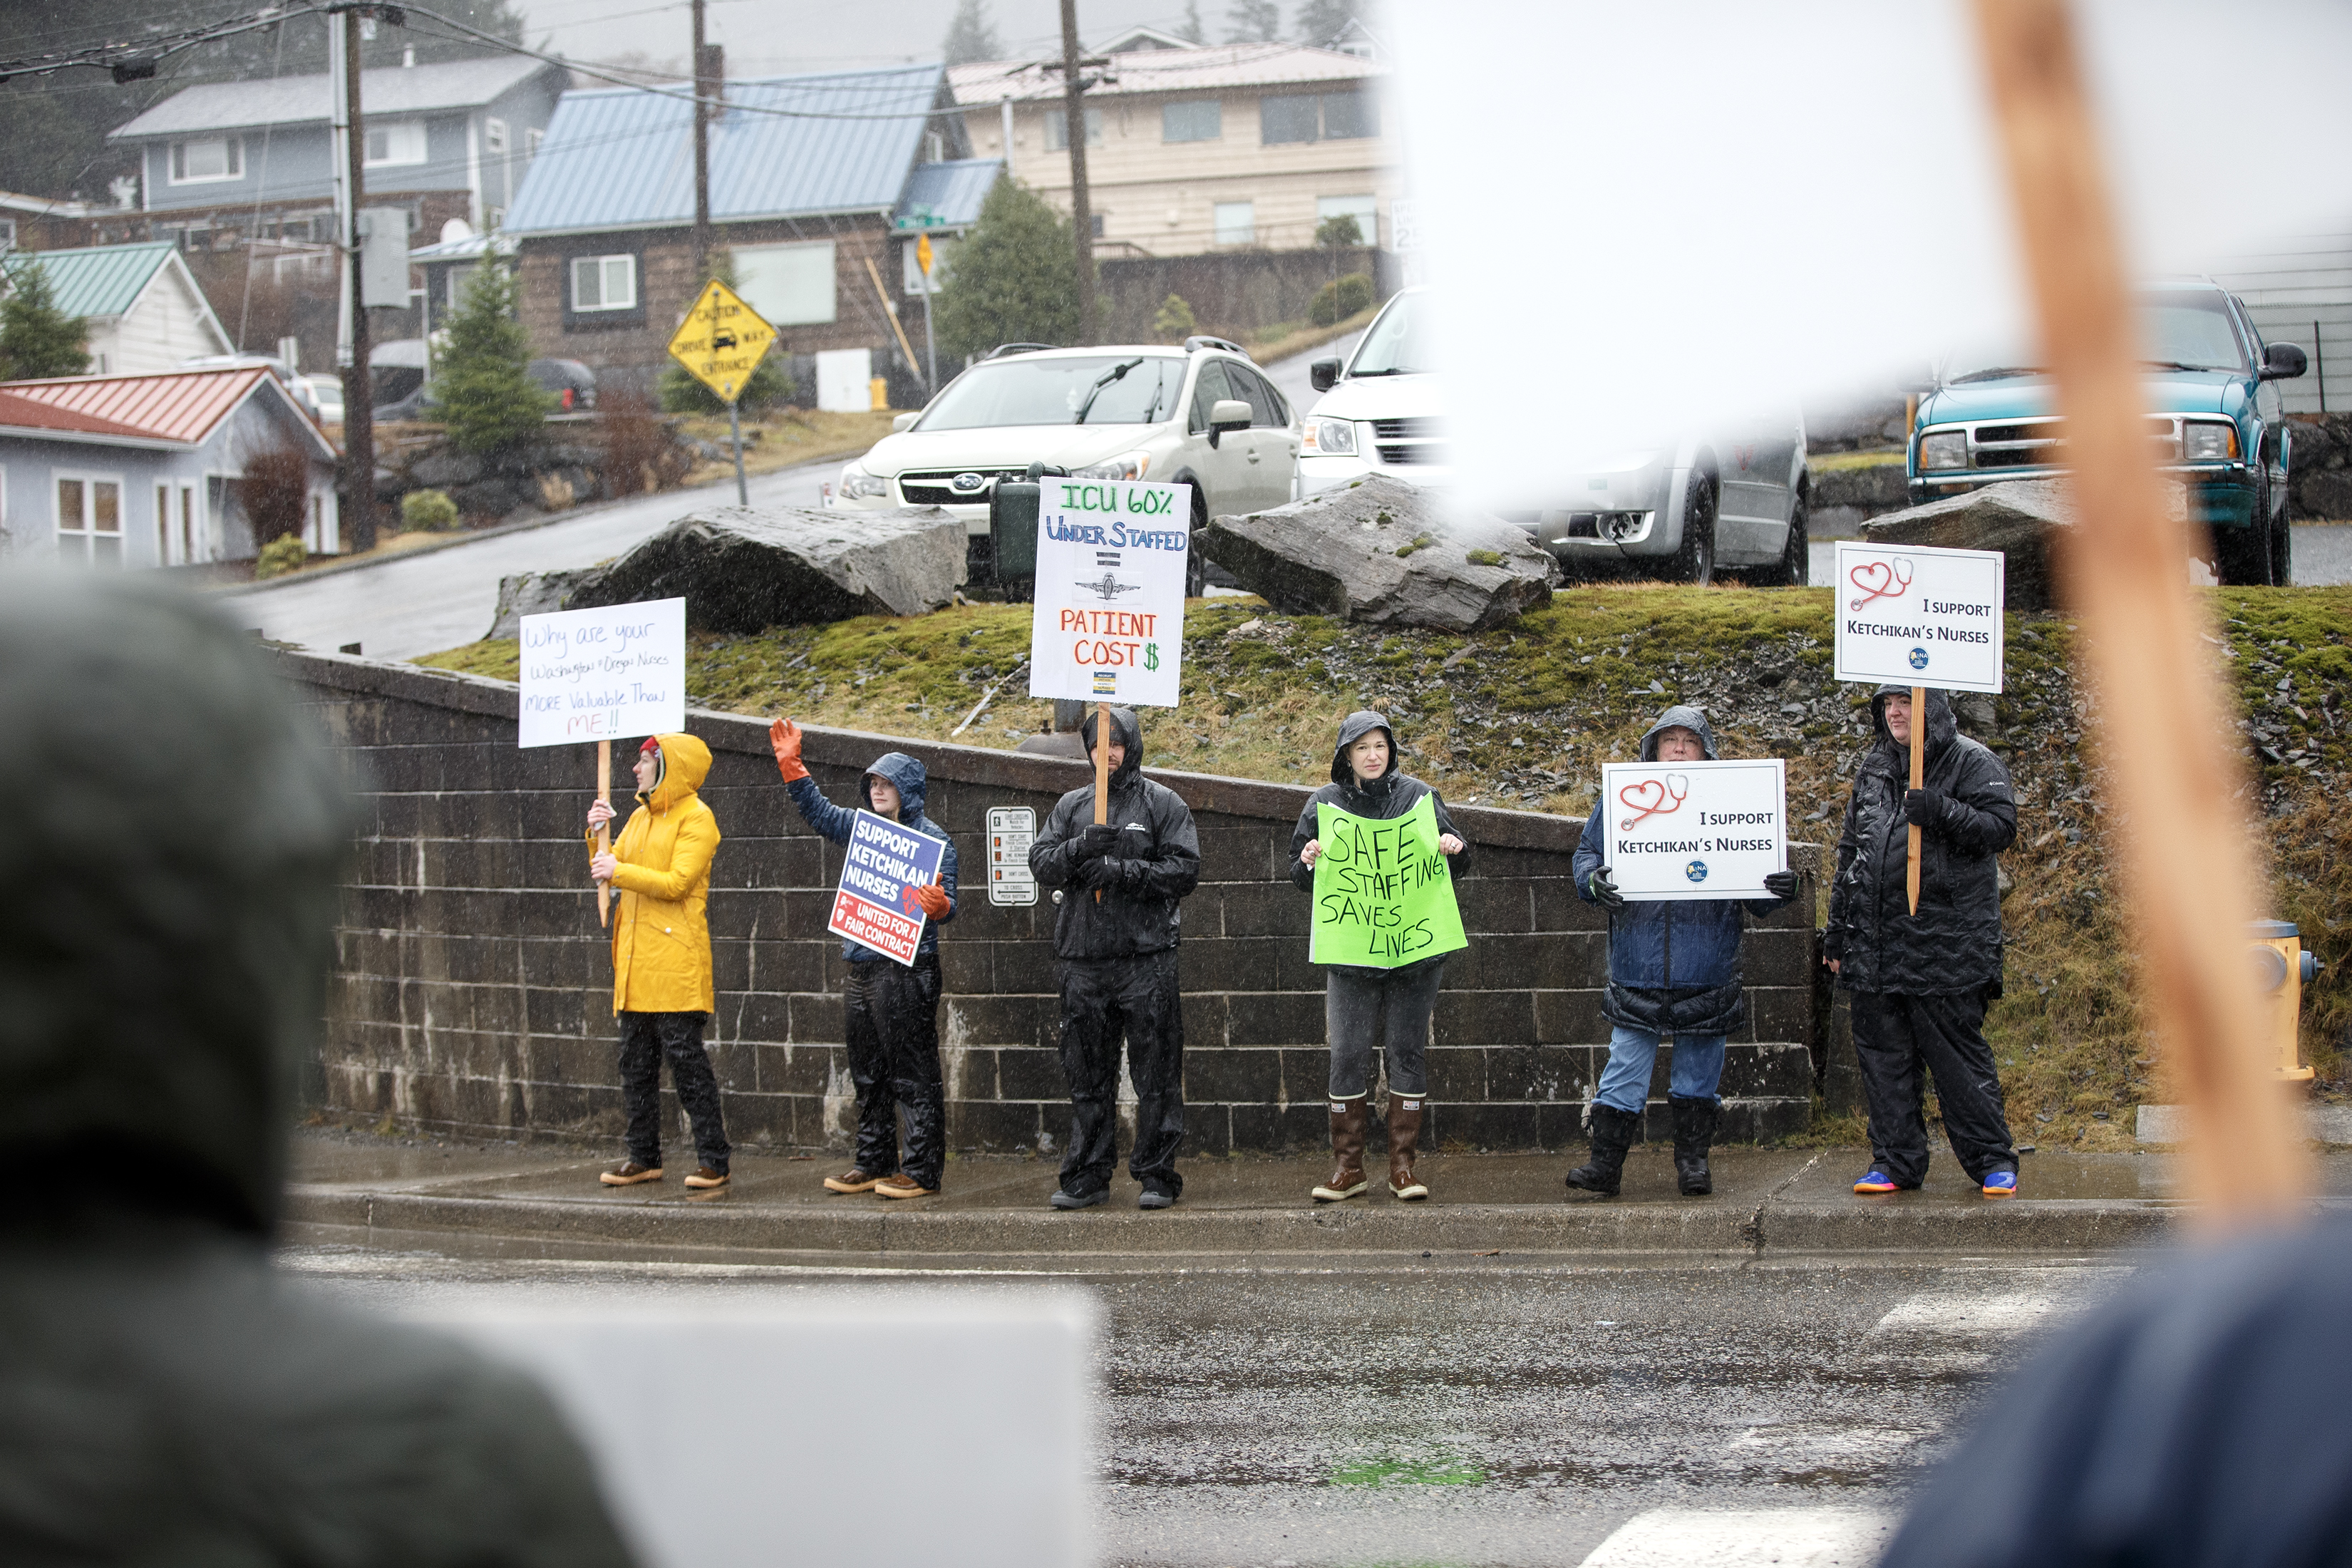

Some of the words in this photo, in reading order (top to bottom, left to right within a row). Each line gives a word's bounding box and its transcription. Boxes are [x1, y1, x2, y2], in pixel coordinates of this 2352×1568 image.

[695, 305, 741, 323] CAUTION
[701, 357, 749, 376] ENTRANCE
[1061, 484, 1118, 512] ICU
[1127, 488, 1175, 515] 60%
[1046, 515, 1107, 546] UNDER
[1109, 522, 1188, 552] STAFFED
[1061, 609, 1158, 638] PATIENT
[1923, 599, 1929, 612] I
[1932, 602, 1991, 617] SUPPORT
[525, 624, 568, 659] Why
[576, 626, 607, 644] are
[612, 623, 655, 653] your
[1847, 620, 1934, 639] KETCHIKAN'S
[1937, 626, 1989, 644] NURSES
[636, 651, 669, 667] Nurses
[1073, 639, 1140, 667] COST
[1143, 643, 1160, 672] $
[525, 694, 562, 711] MORE
[569, 689, 627, 710] Valuable
[1700, 812, 1706, 825] I
[1710, 813, 1774, 825] SUPPORT
[855, 820, 920, 860] SUPPORT
[1324, 817, 1418, 870] SAFE
[1618, 837, 1712, 854] KETCHIKAN'S
[1716, 837, 1773, 852] NURSES
[850, 842, 929, 888] KETCHIKAN
[1336, 850, 1445, 901] STAFFING
[845, 865, 899, 902] NURSES
[857, 902, 891, 929] UNITED
[890, 917, 910, 937] FOR
[908, 927, 917, 942] A
[1320, 894, 1402, 928] SAVES
[844, 915, 865, 937] FAIR
[865, 925, 914, 957] CONTRACT
[1368, 918, 1434, 959] LIVES
